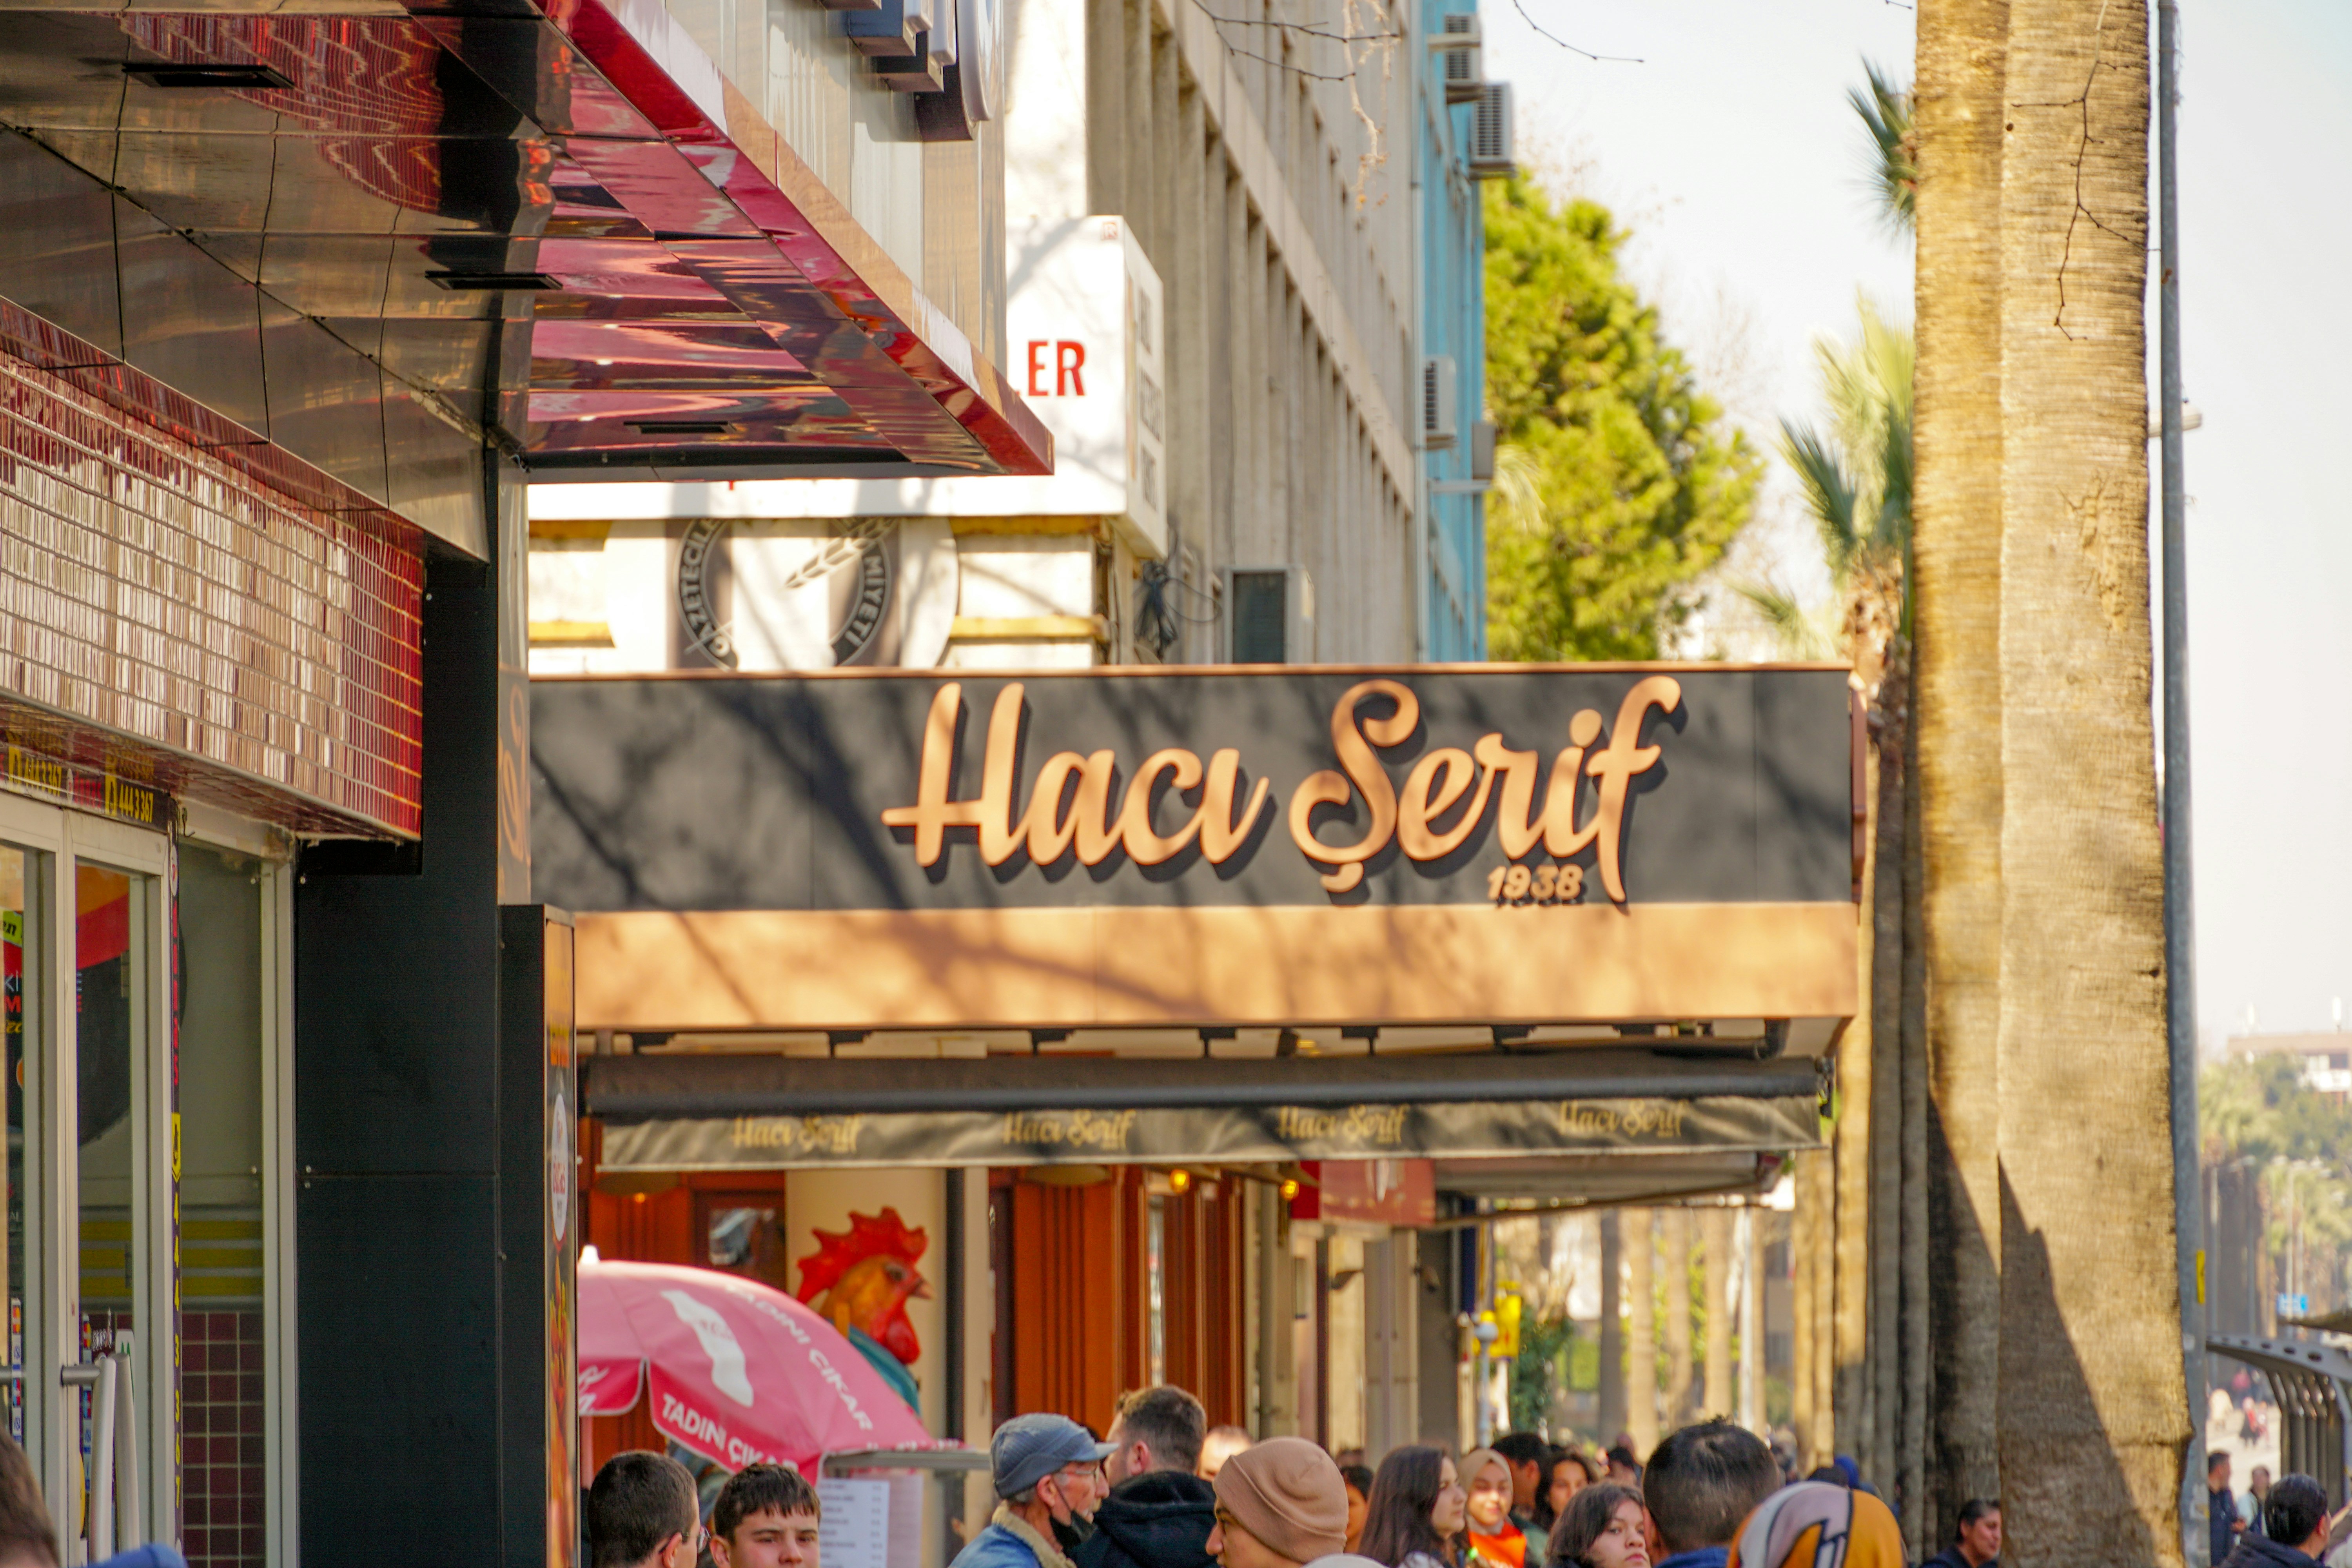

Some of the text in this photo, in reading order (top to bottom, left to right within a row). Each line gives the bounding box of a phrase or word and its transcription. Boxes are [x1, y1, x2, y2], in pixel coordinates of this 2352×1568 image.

[1015, 339, 1086, 397] ER
[881, 674, 1682, 904] Hacı Şerif
[1487, 864, 1584, 900] 1938
[662, 1392, 799, 1473] TADINI ÇIK
